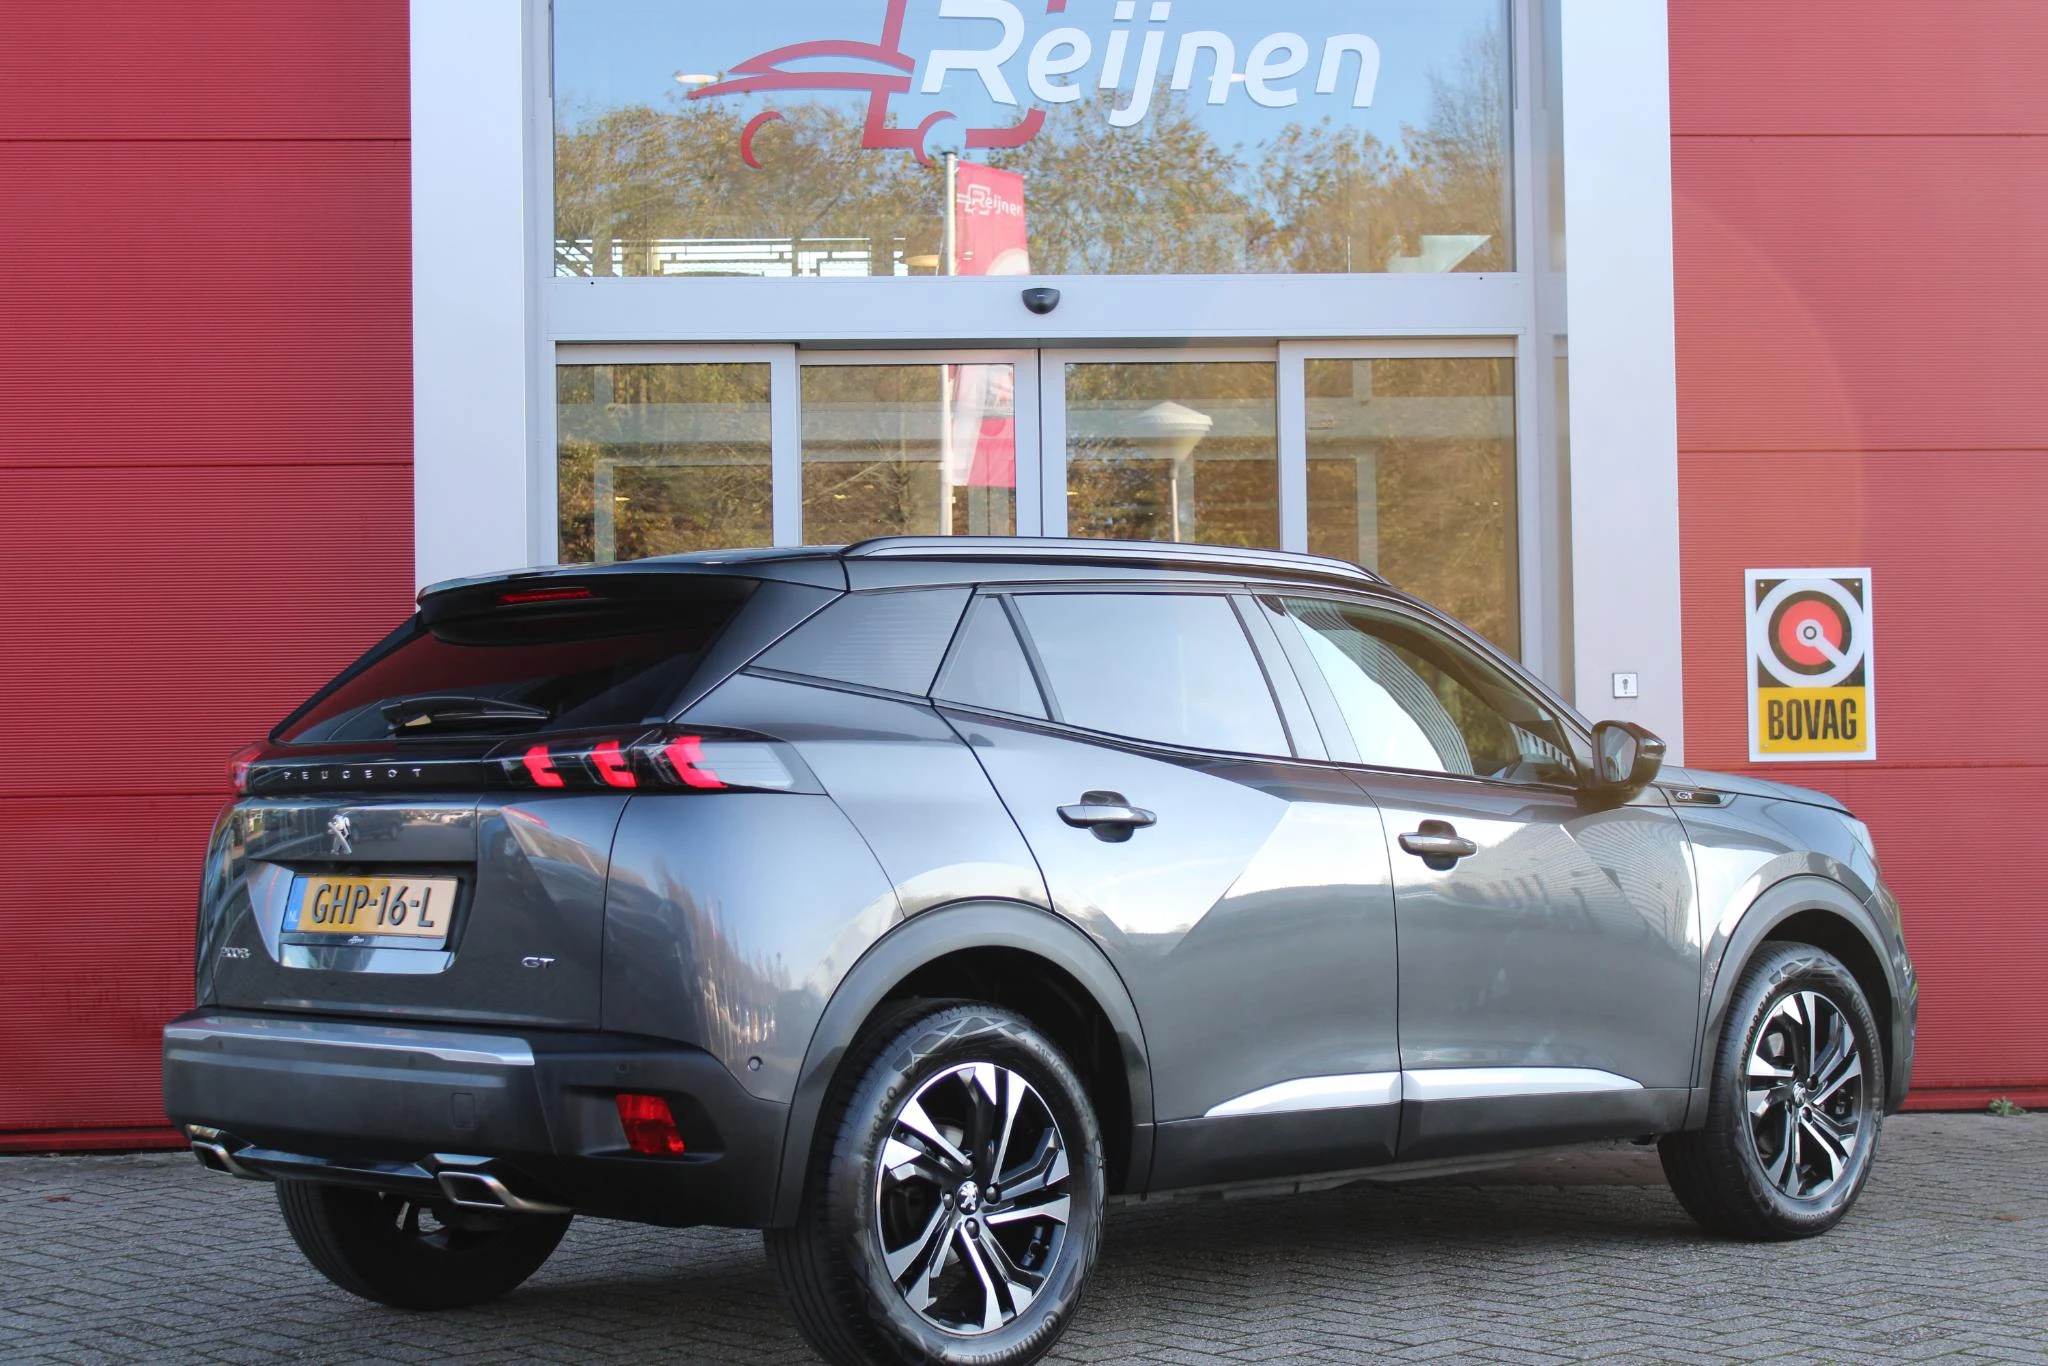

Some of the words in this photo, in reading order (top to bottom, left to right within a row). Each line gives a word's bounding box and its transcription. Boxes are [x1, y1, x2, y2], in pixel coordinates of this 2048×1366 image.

[921, 0, 1381, 127] Reijnen
[1767, 698, 1857, 741] BOVAG
[283, 768, 422, 780] PEUGEOT
[1676, 791, 1695, 800] GT
[311, 883, 434, 928] GHP-16-L
[521, 956, 556, 969] GT
